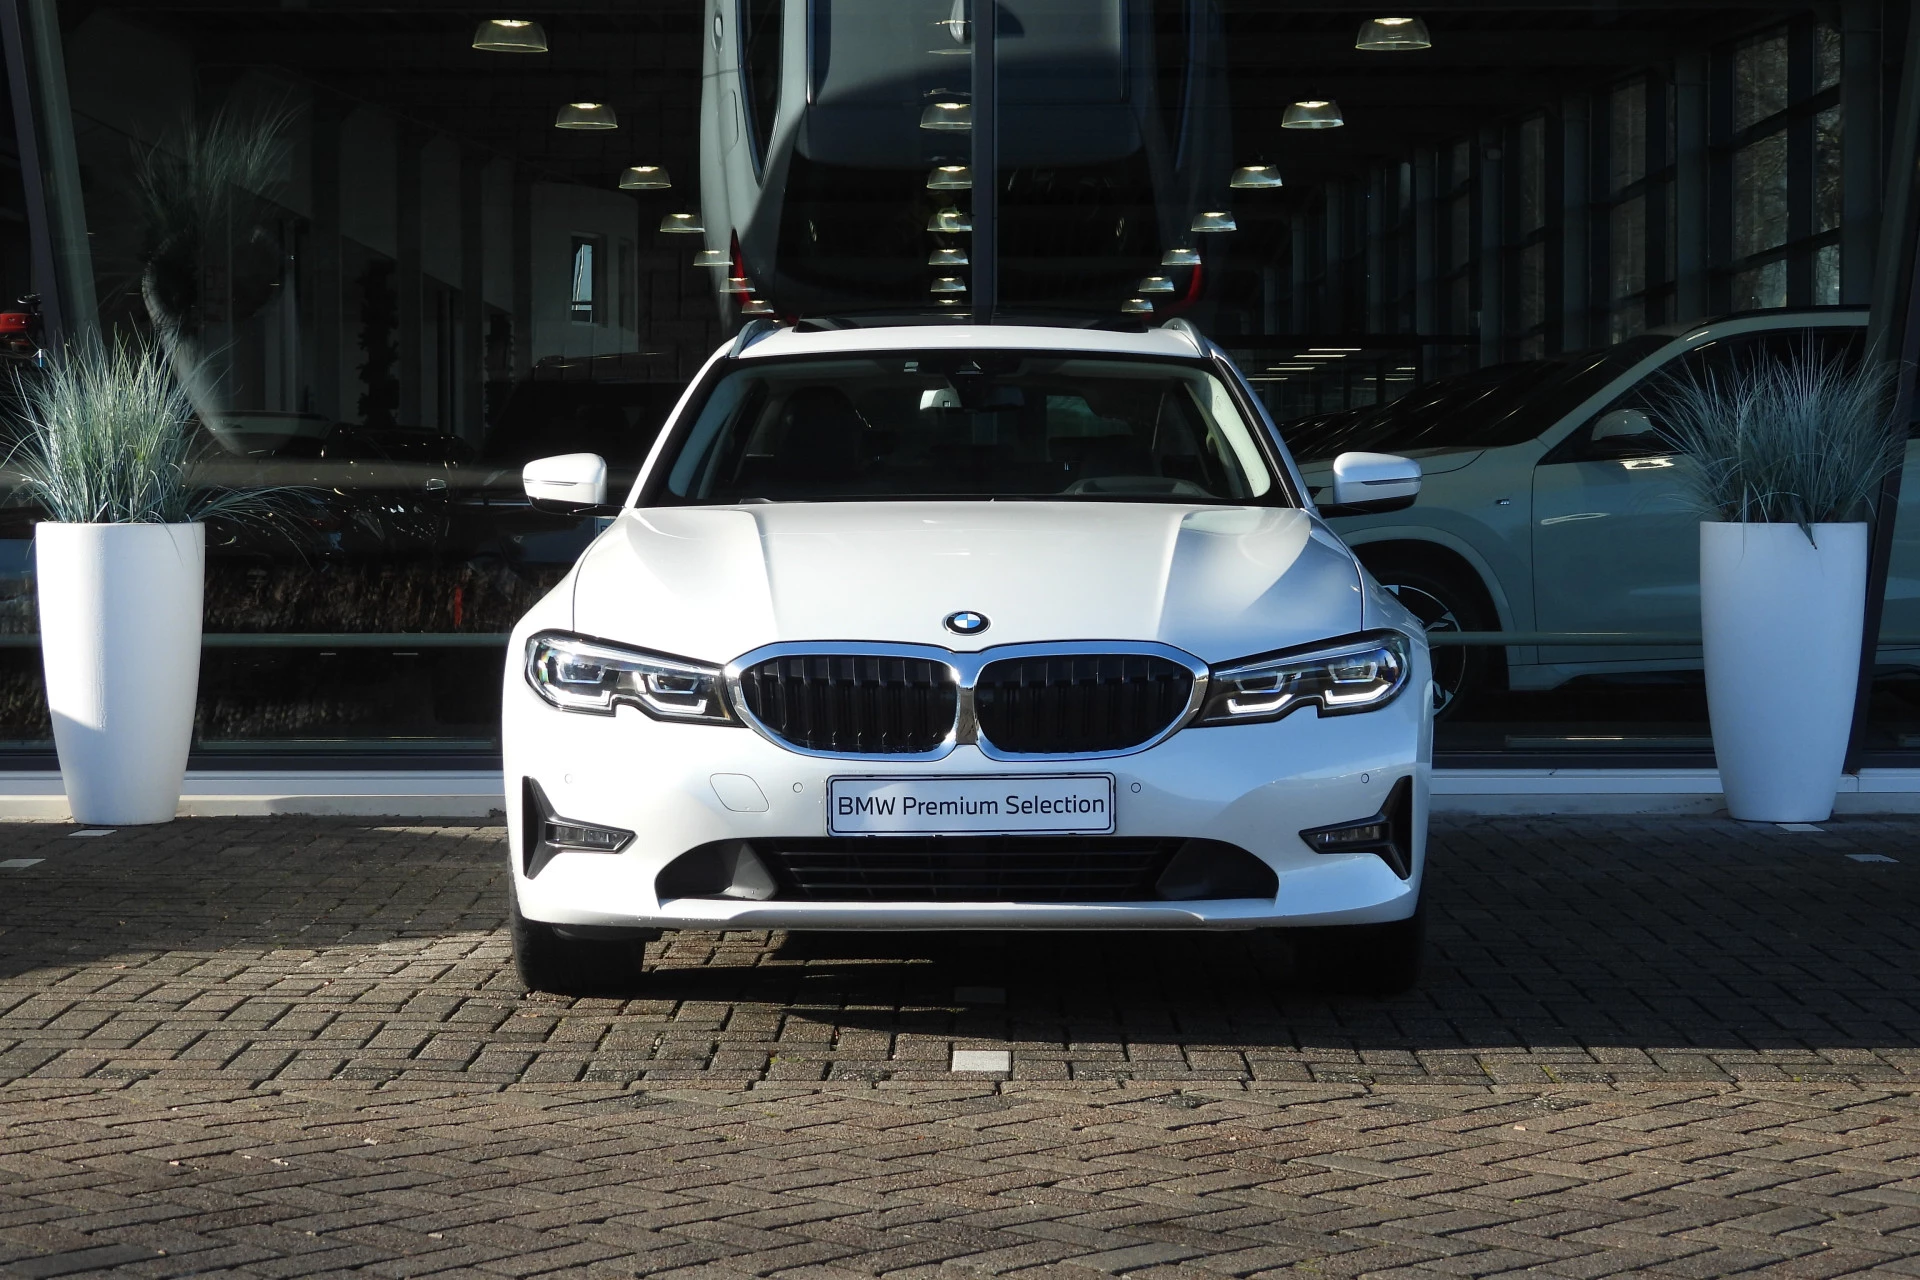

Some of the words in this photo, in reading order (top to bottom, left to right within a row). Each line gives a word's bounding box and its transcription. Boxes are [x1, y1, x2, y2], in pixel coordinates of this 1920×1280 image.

[838, 796, 896, 815] BMW
[903, 796, 998, 815] Premium
[1005, 795, 1105, 814] Selection
